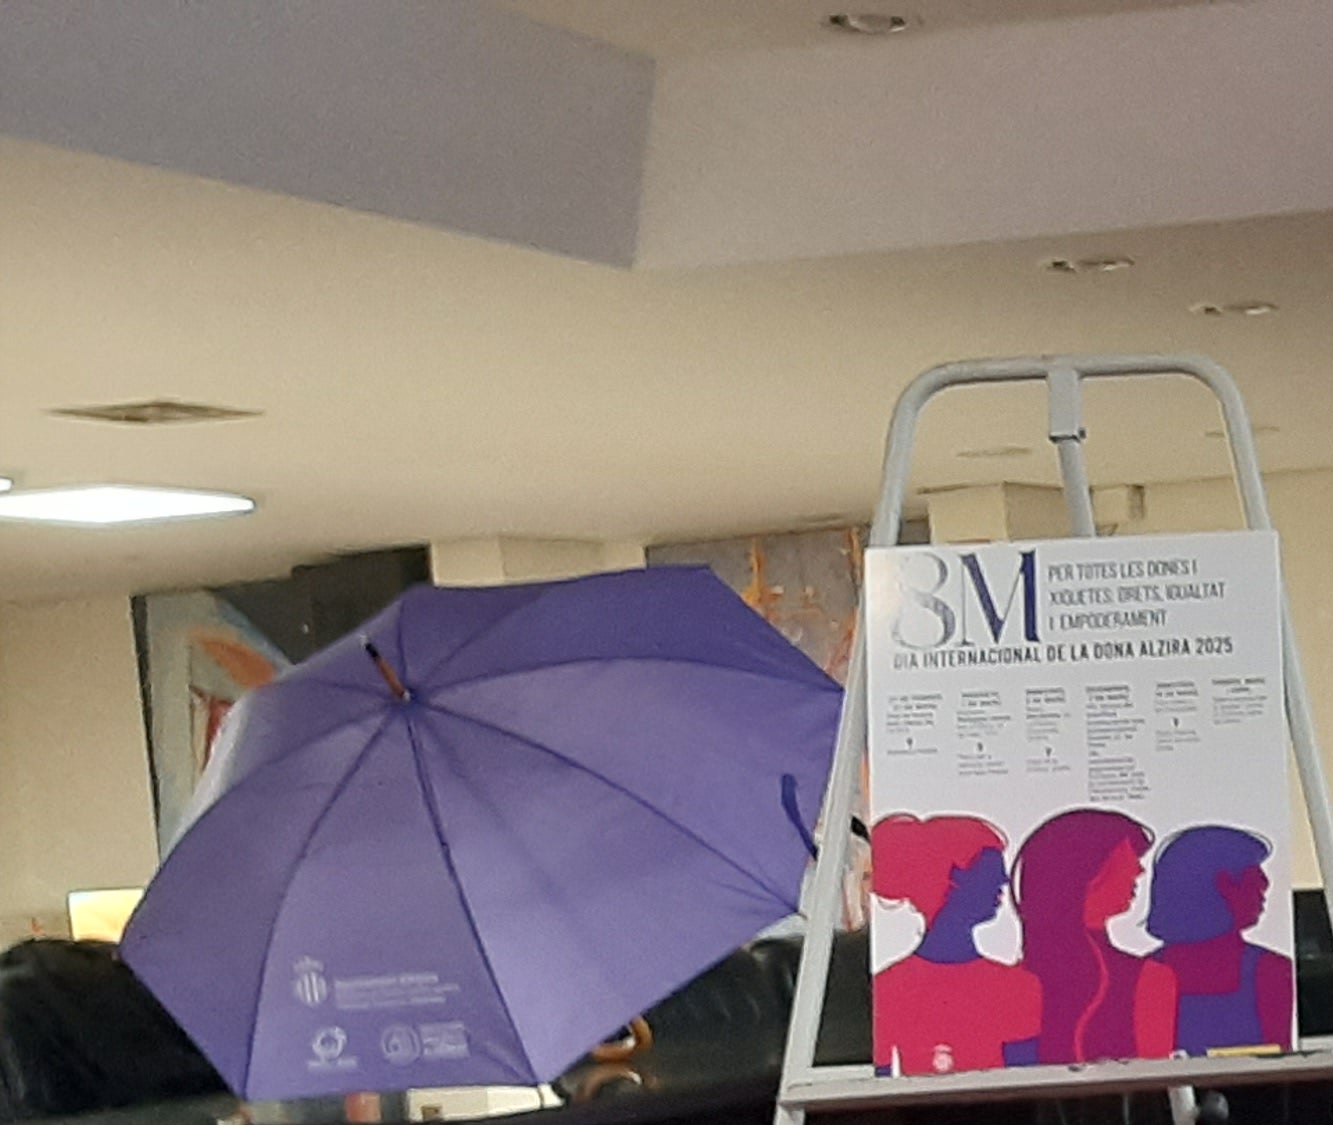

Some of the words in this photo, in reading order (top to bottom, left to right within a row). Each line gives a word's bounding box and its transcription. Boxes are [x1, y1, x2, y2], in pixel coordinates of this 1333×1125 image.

[1048, 564, 1074, 582] PER
[1076, 562, 1118, 580] TOTES
[1120, 560, 1144, 578] LES
[1147, 559, 1189, 577] DONES
[891, 548, 1041, 650] 8M
[1165, 581, 1225, 601] IGUALTAT
[1060, 609, 1167, 630] EMPODERAMENT
[893, 652, 919, 669] DIA
[923, 646, 1041, 668] INTERNACIONAL
[1047, 645, 1065, 662] DE
[1070, 643, 1089, 661] LA
[1093, 641, 1135, 660] DONA
[1139, 638, 1191, 658] ALZIRA
[1195, 636, 1233, 655] 2025
